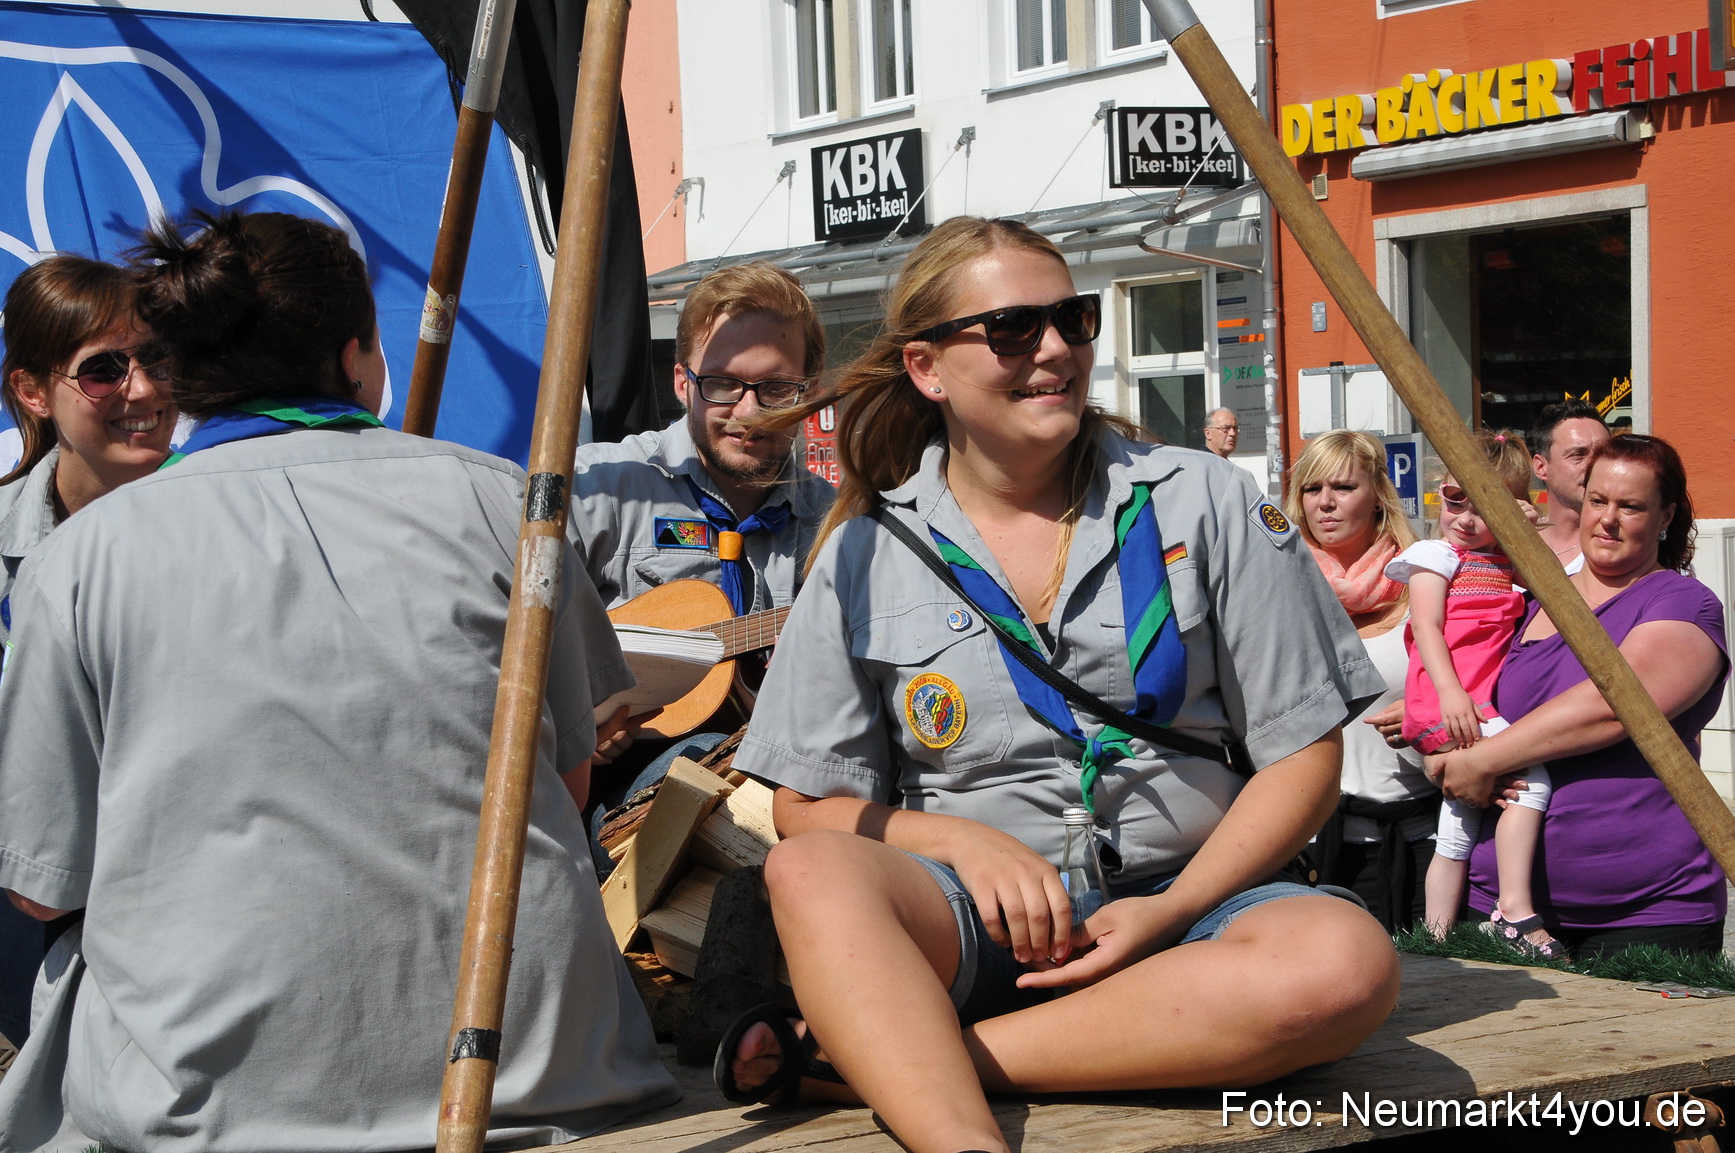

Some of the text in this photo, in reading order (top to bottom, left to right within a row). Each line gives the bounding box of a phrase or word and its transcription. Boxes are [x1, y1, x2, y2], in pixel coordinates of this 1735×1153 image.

[1282, 94, 1366, 158] DER
[1376, 68, 1568, 143] BÄCKER
[1127, 113, 1236, 153] KBK
[822, 136, 907, 202] KBK
[1235, 364, 1265, 380] DEKRA
[1394, 453, 1411, 489] P
[931, 678, 955, 695] ALLGÄU
[953, 698, 962, 730] BAYERN
